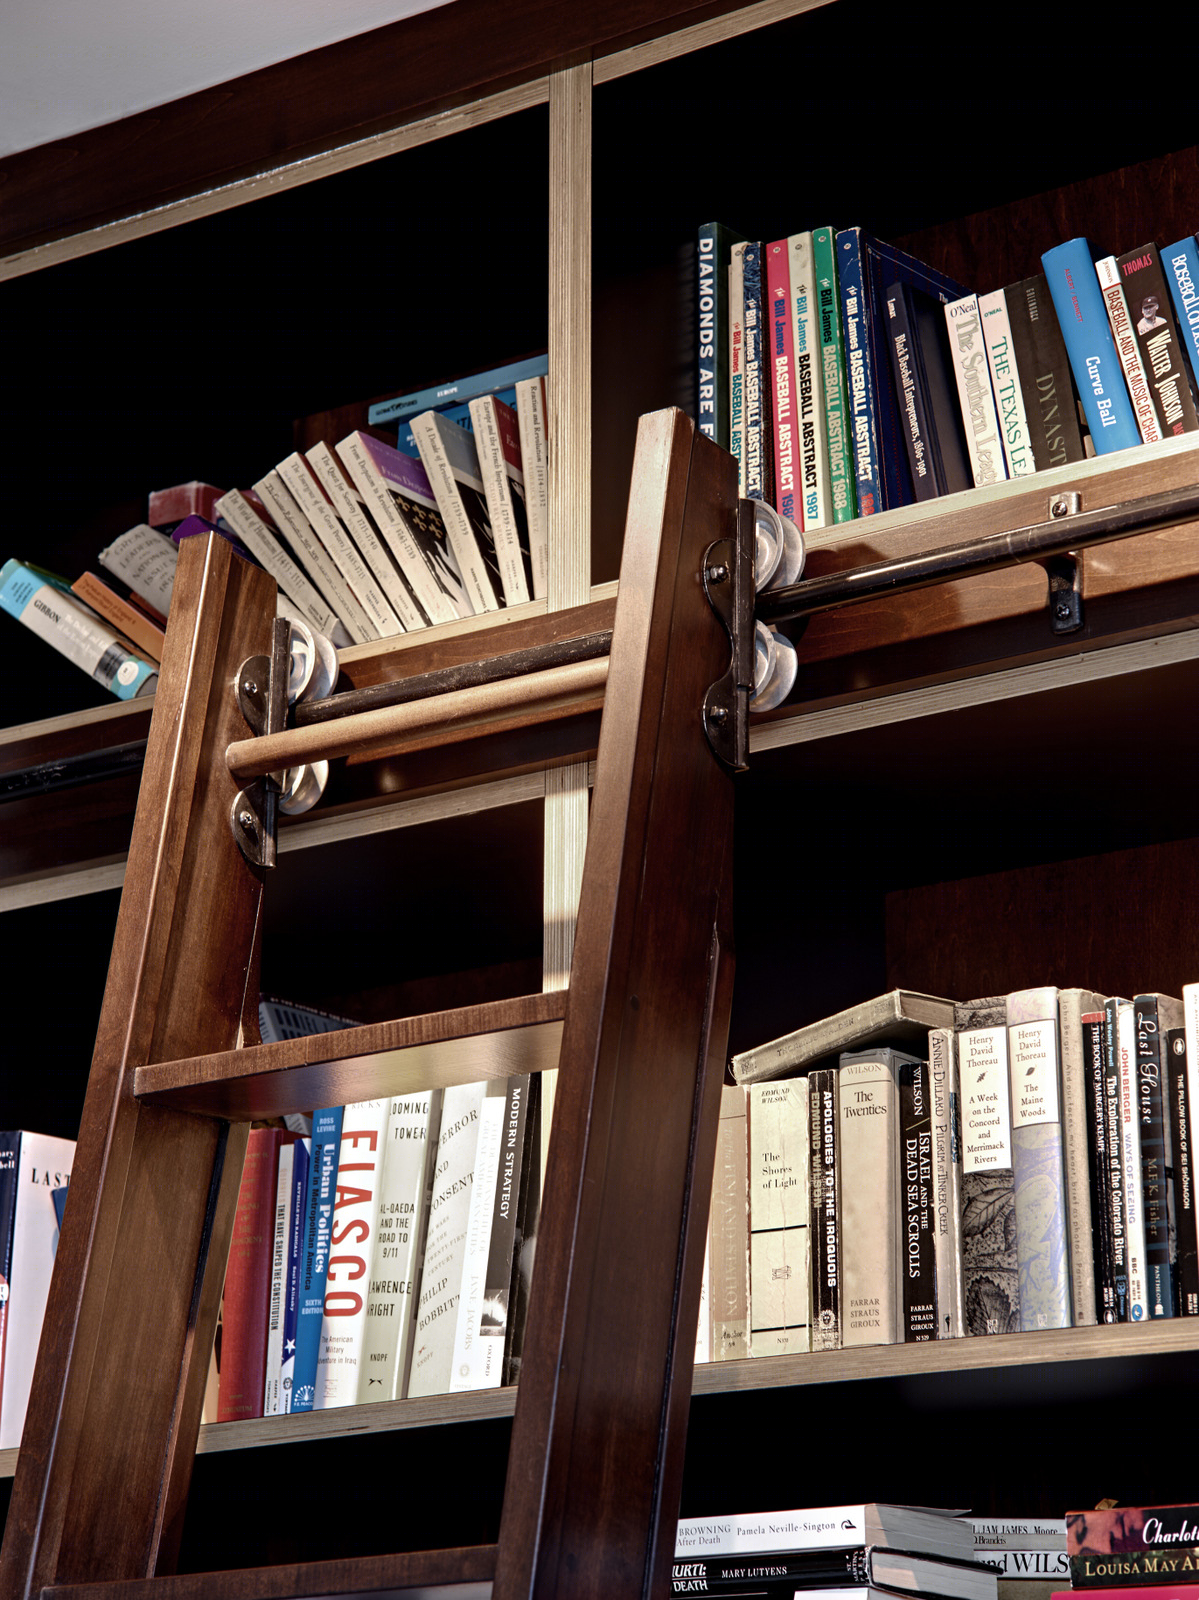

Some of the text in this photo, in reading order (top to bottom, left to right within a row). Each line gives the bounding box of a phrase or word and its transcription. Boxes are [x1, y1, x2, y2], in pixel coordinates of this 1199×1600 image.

[1122, 254, 1152, 276] THOMAS
[1064, 268, 1083, 323] ALBERT BENNETT
[700, 238, 713, 413] DIAMONDS ARE
[894, 333, 914, 388] Black Baseball
[1107, 290, 1152, 416] BASEBALL AND THE MUSIC OF
[732, 330, 742, 428] Bill James BASEBALL
[956, 313, 989, 437] The Southern
[1146, 329, 1184, 425] WALTER JOHNSON
[746, 309, 761, 491] Bill James BASEBALL ABSTRACT
[774, 299, 793, 491] Bill James BASEBALL ABSTRACT
[821, 288, 847, 509] Bill James BASEBALL ABSTRACT 1988
[846, 297, 872, 481] Bill James BASEBALL ABSTRACT
[992, 336, 1021, 445] THE TEXAS
[1086, 356, 1116, 428] Curve Ball
[797, 296, 818, 519] Bill James BASEBALL ABSTRACT 1987
[1036, 373, 1068, 464] DYNAST
[534, 427, 542, 463] Revolution
[483, 401, 491, 421] Europe
[491, 446, 500, 470] French
[501, 509, 513, 545] 1799-1814
[327, 465, 339, 481] Quest
[357, 518, 379, 551] 1715-1740
[439, 461, 453, 495] Revolution
[452, 501, 468, 536] 1789-1799
[34, 600, 61, 624] GIBBON
[969, 1035, 993, 1046] Henry
[1018, 1029, 1041, 1040] Henry
[1019, 1039, 1041, 1050] David
[970, 1046, 993, 1056] David
[1016, 1051, 1046, 1063] Thoreau
[1092, 1046, 1101, 1069] BOOK
[847, 1064, 882, 1075] WILSON
[966, 1058, 998, 1068] Thoreau
[1138, 1012, 1159, 1123] Last House
[932, 1037, 946, 1117] ANNIE DILLARD
[1024, 1084, 1038, 1093] The
[1121, 1047, 1131, 1123] JOHN BERGER
[854, 1091, 873, 1103] The
[913, 1066, 923, 1116] WILSON
[977, 1093, 998, 1102] Week
[1021, 1096, 1043, 1106] Maine
[844, 1104, 887, 1119] Twenties
[983, 1106, 995, 1114] the
[1020, 1107, 1046, 1118] Woods
[1178, 1090, 1186, 1117] PILLOW
[811, 1092, 821, 1150] EDMUND
[969, 1117, 1000, 1128] Concord
[395, 1128, 427, 1140] TOWER
[936, 1124, 947, 1163] PILGRIM
[978, 1130, 991, 1139] and
[500, 1088, 521, 1220] MODERN STRATEGY
[762, 1153, 780, 1162] The
[967, 1141, 1004, 1153] Merrimack
[1180, 1141, 1187, 1152] OF
[762, 1166, 792, 1176] Shores
[974, 1155, 997, 1164] Rivers
[1107, 1076, 1125, 1266] The Exploration of the Colorado River
[762, 1177, 797, 1190] of Light
[823, 1091, 836, 1287] APOLOGIES TO THE IROQUOIS
[919, 1131, 931, 1230] ISRAEL AND THE
[1125, 1133, 1136, 1224] WAYS OF SEEING
[305, 1144, 323, 1291] Power in Metropolitan America
[315, 1143, 335, 1274] Urban Politics
[906, 1138, 920, 1278] DEAD SEA SCROLLS
[1150, 1200, 1160, 1236] Fisher
[323, 1131, 378, 1317] FIASCO
[380, 1218, 409, 1228] AND THE
[378, 1233, 408, 1244] ROAD TO
[382, 1248, 398, 1258] 9/11
[271, 1240, 284, 1331] SHAPED CONSTITUTION
[850, 1299, 880, 1307] FARRAR
[850, 1309, 880, 1318] STRAUS
[911, 1304, 934, 1312] FARRAR
[850, 1320, 880, 1329] GIROUX
[911, 1323, 934, 1331] GIROUX
[370, 1353, 388, 1362] KNOPF
[679, 1521, 836, 1536] BROWNING Pamela Neville-Sington
[677, 1535, 721, 1547] After Death
[721, 1566, 787, 1579] MARY LUTYENS
[1085, 1558, 1178, 1576] LOUISA MAY
[673, 1580, 708, 1592] DEATH
